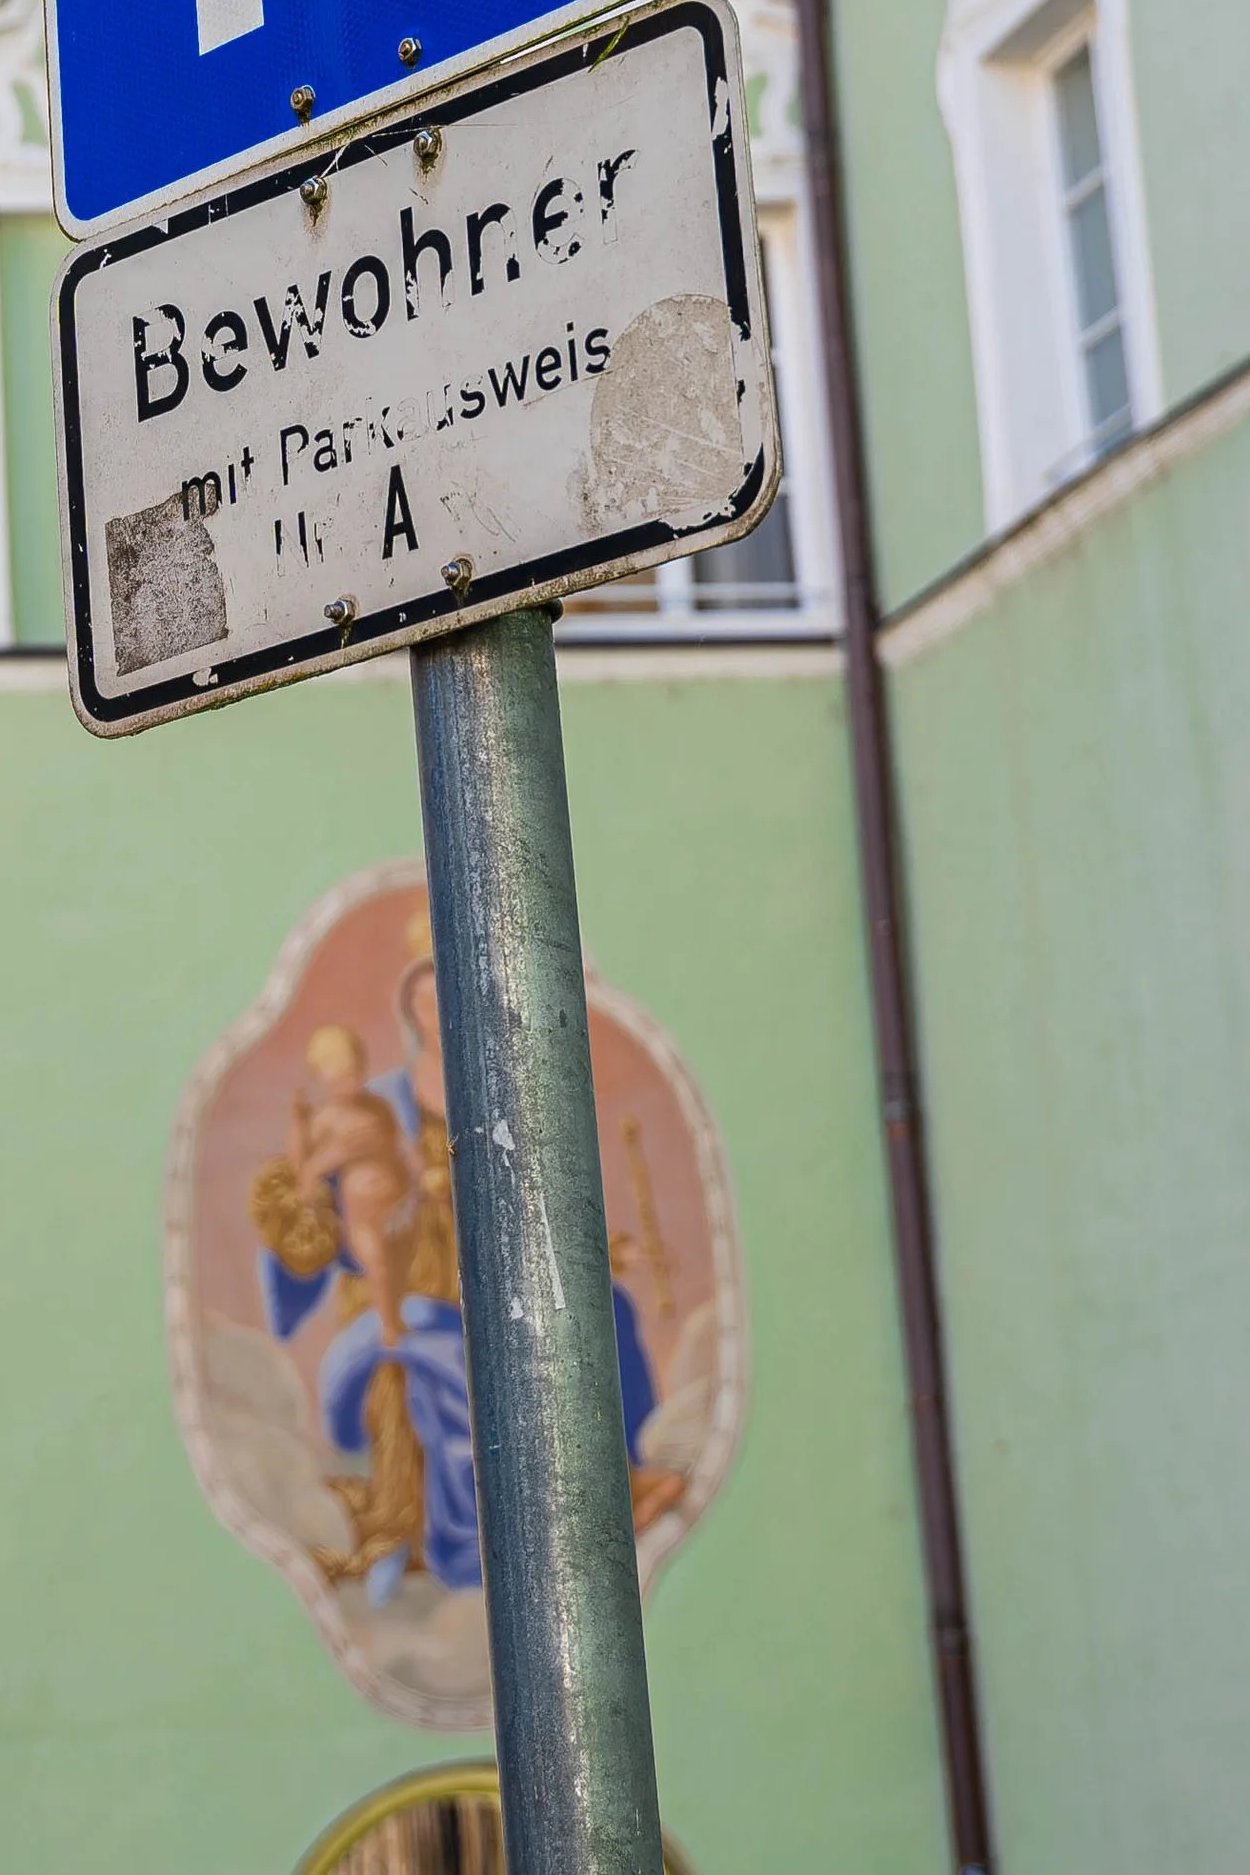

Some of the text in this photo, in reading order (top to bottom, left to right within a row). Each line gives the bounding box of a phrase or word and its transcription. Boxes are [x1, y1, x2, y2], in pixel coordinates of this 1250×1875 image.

[132, 148, 640, 423] Bewohner
[181, 445, 254, 521] mit
[382, 464, 419, 560] A
